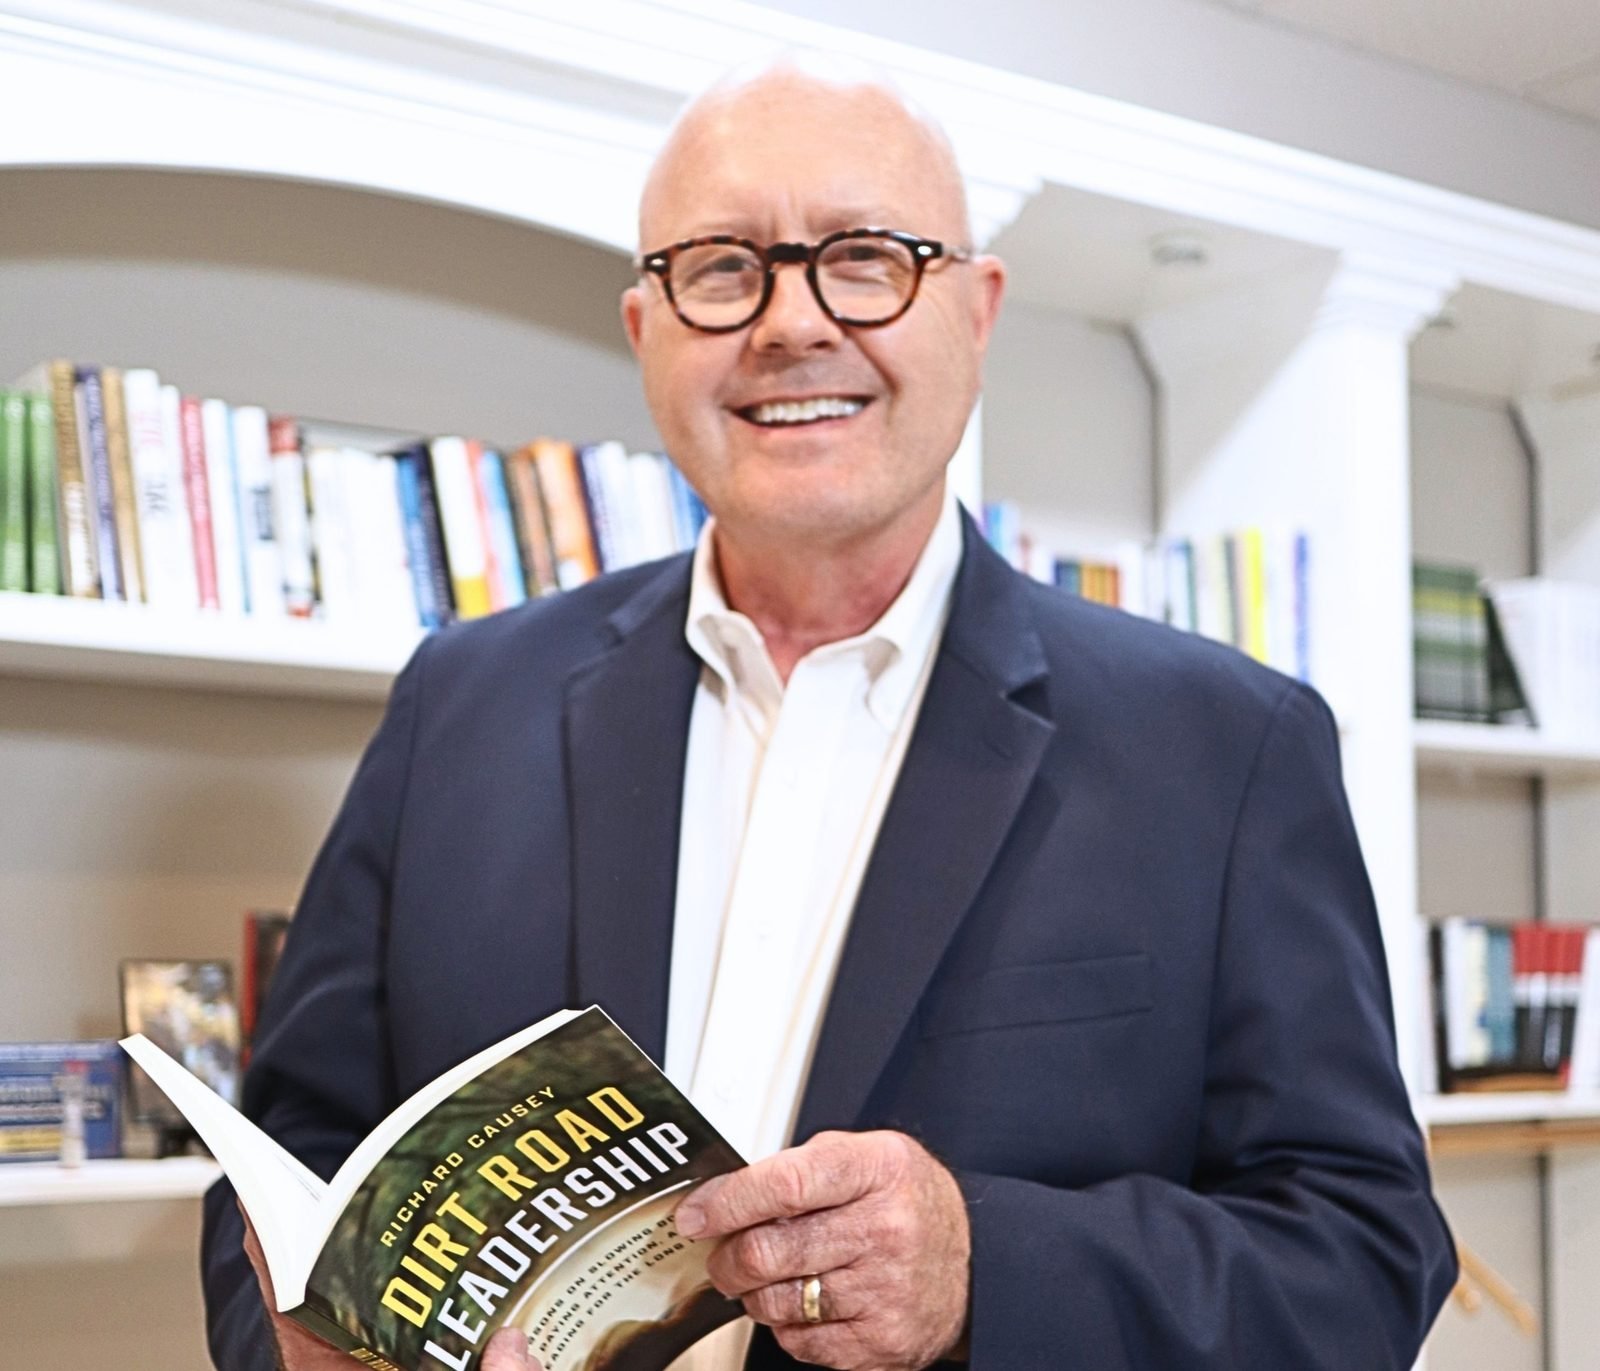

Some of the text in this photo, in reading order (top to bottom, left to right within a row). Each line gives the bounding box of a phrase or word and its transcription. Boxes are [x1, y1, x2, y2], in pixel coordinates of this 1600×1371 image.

[380, 1086, 555, 1247] RICHARD CAUSEY
[380, 1086, 645, 1328] DIRT ROAD
[423, 1122, 689, 1371] LEADERSHIP
[528, 1298, 565, 1345] SSONS
[566, 1276, 586, 1295] ON
[588, 1227, 653, 1274] SLOWING
[544, 1242, 684, 1371] EADING FOR THE LONG
[539, 1302, 581, 1352] PAYING
